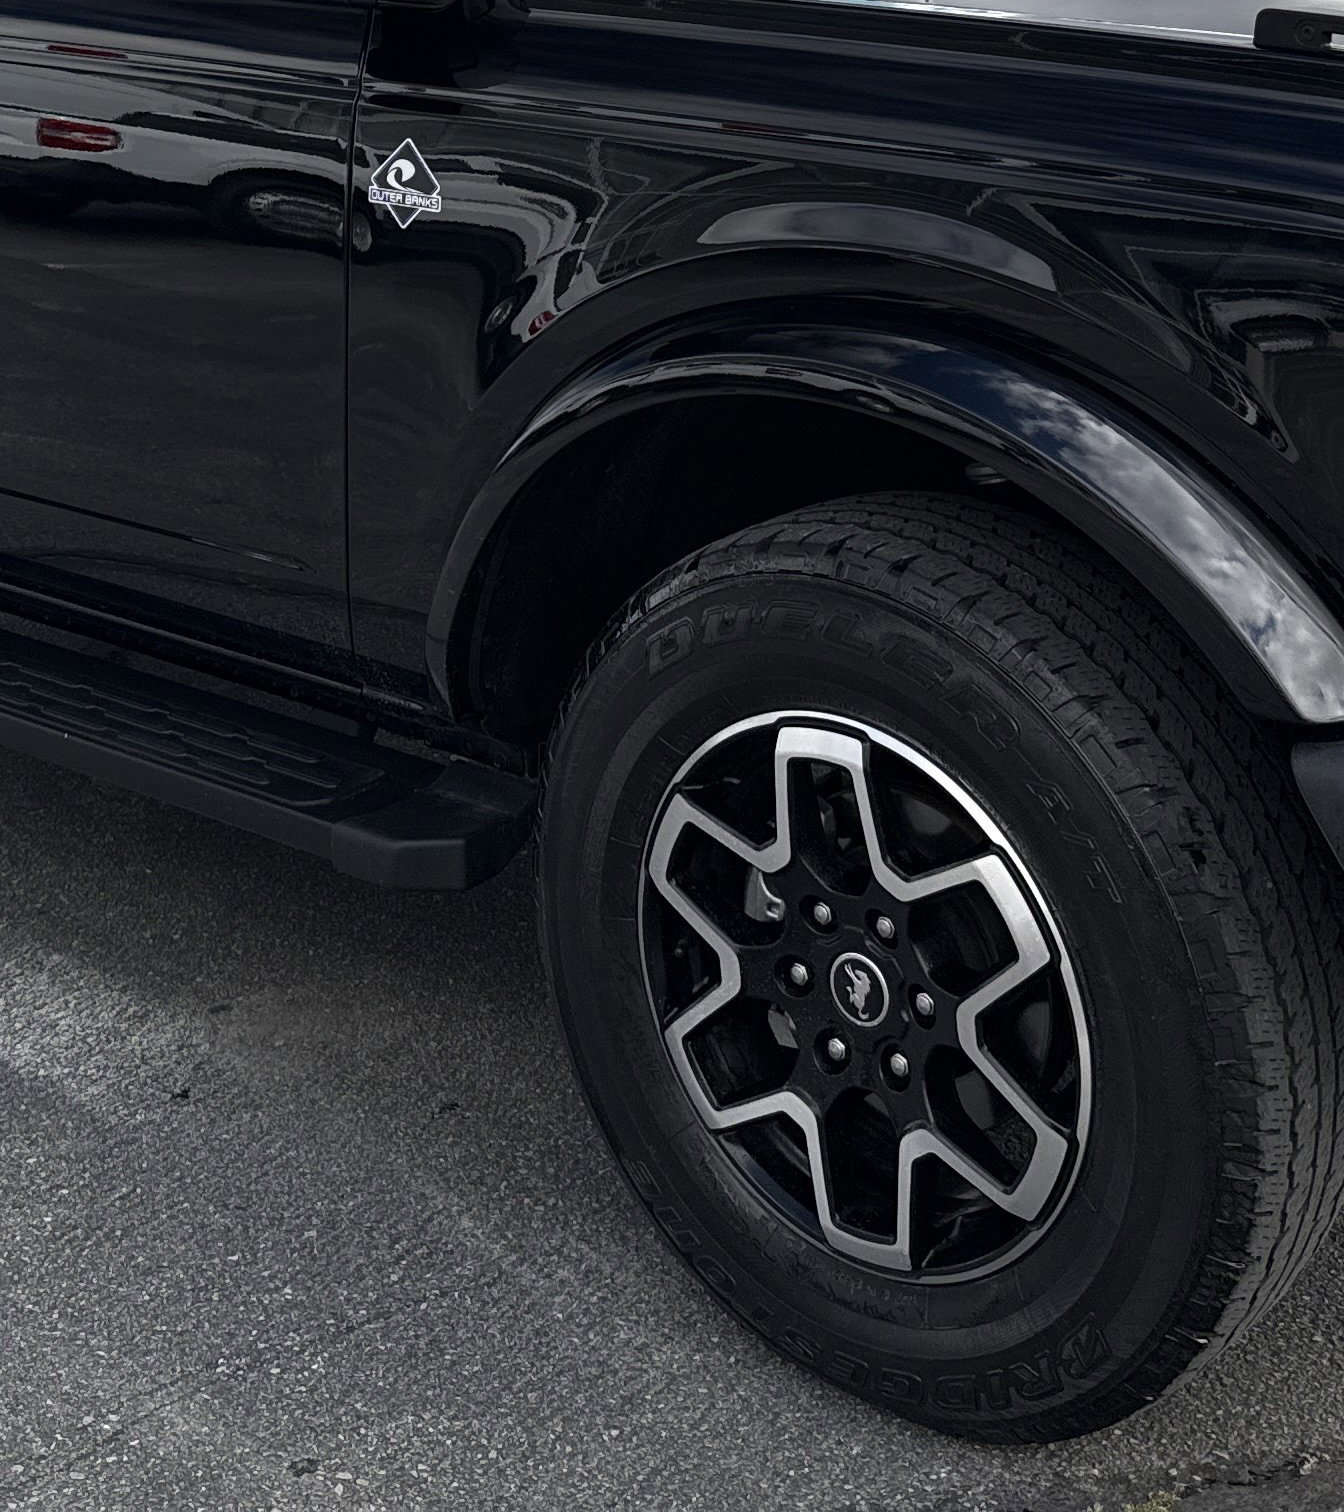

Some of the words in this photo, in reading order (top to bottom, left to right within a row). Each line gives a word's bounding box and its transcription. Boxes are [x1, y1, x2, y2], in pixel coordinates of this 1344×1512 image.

[371, 189, 403, 204] OUTER
[404, 194, 439, 209] BANKS
[646, 599, 1023, 753] DUELER
[1020, 774, 1128, 906] A/T
[621, 1153, 1119, 1412] BRIDGESTONE
